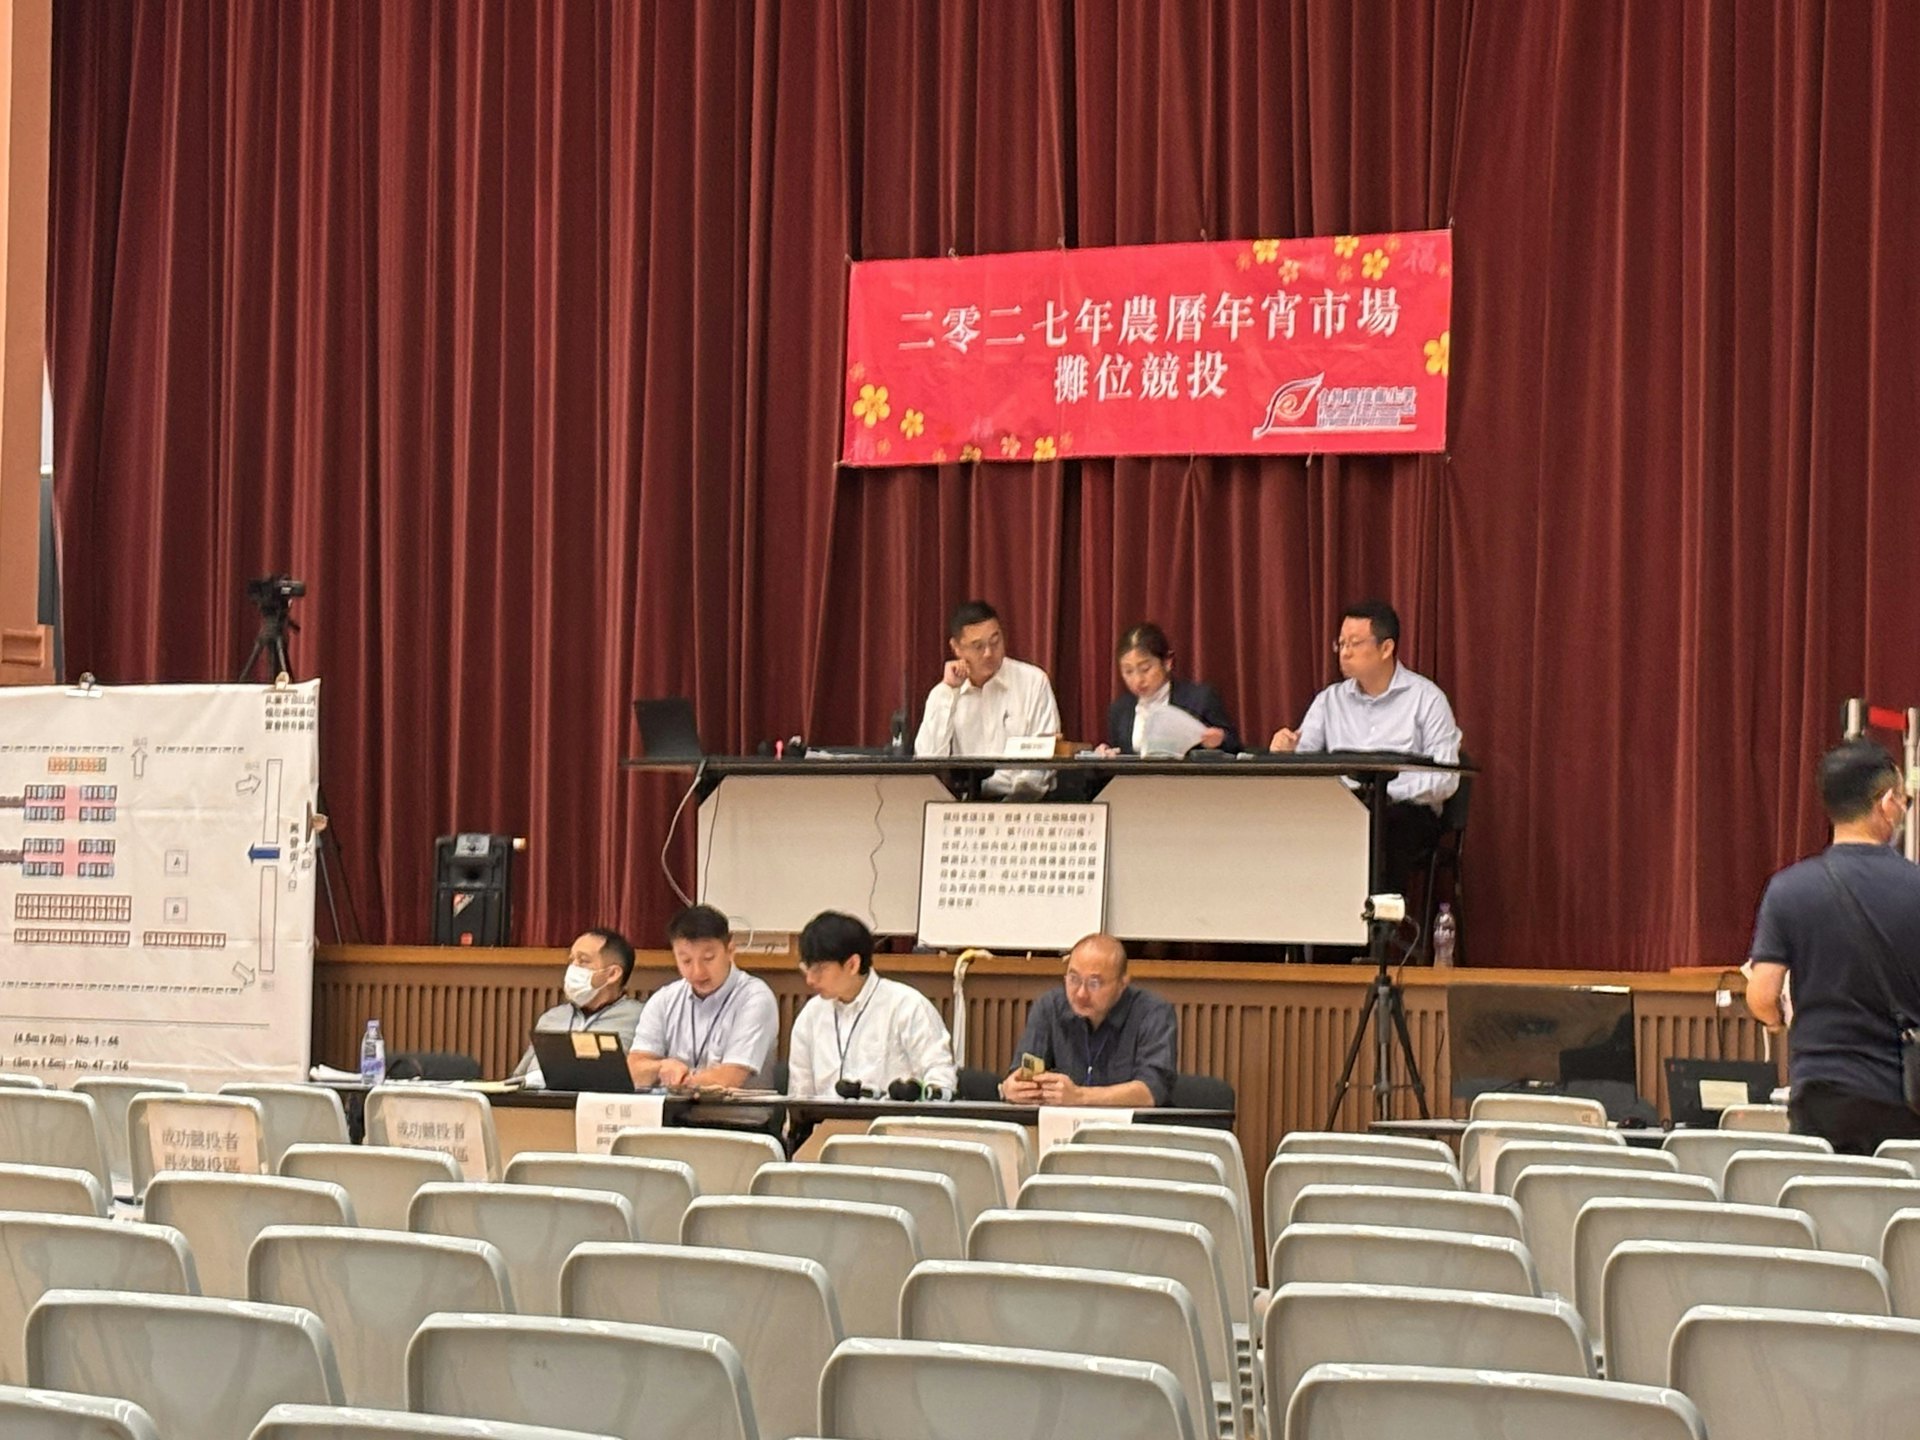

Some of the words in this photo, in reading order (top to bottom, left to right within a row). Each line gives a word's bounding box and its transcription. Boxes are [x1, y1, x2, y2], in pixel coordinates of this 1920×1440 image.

[898, 286, 1401, 354] 二零二七年農曆年宵市場
[1056, 351, 1228, 403] 攤位競投
